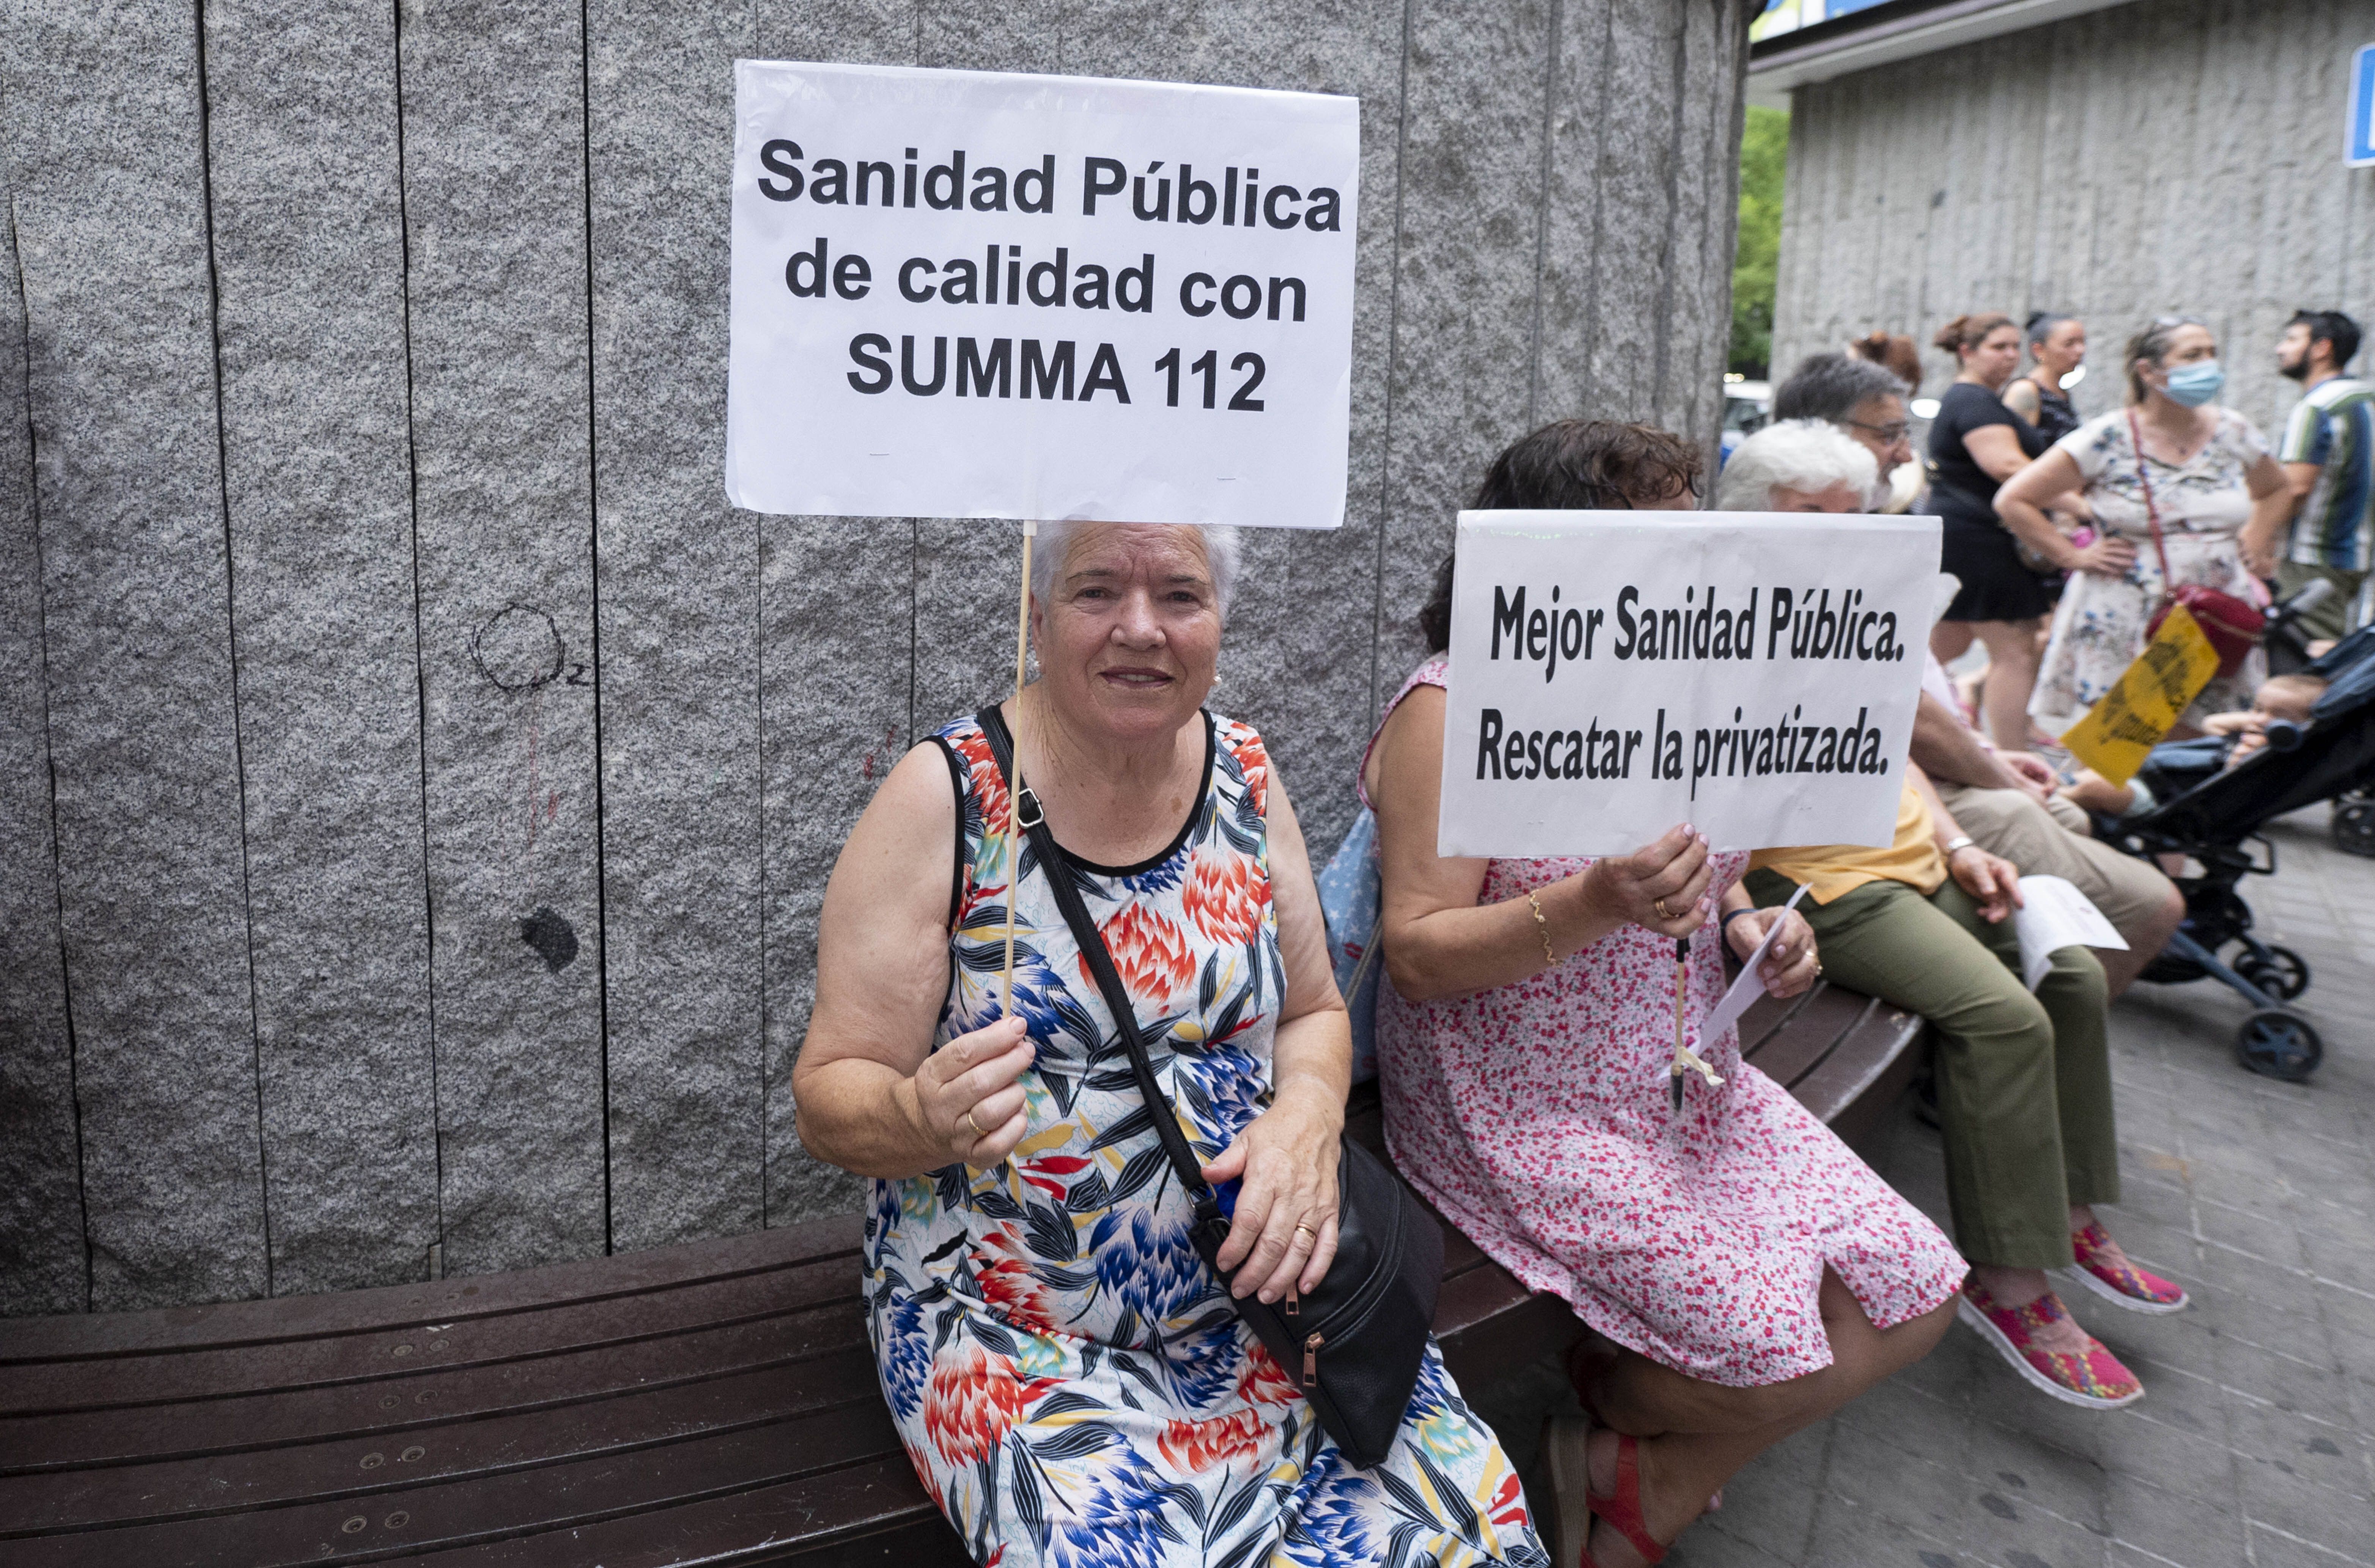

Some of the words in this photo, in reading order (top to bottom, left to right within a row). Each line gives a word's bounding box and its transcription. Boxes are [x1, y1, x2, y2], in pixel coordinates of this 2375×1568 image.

[758, 139, 1055, 214] Sanidad
[1082, 156, 1341, 232] Pública
[785, 237, 872, 300] de
[898, 244, 1155, 313] calidad
[1180, 272, 1306, 322] con
[846, 333, 1132, 404] SUMMA
[1154, 347, 1266, 412] 112
[1490, 585, 1604, 684] Mejor
[1614, 585, 1758, 661] Sanidad
[1767, 587, 1904, 662] Pública.
[1476, 708, 1642, 781] Rescatar
[1651, 708, 1683, 781] la
[1691, 704, 1888, 802] privatizada.
